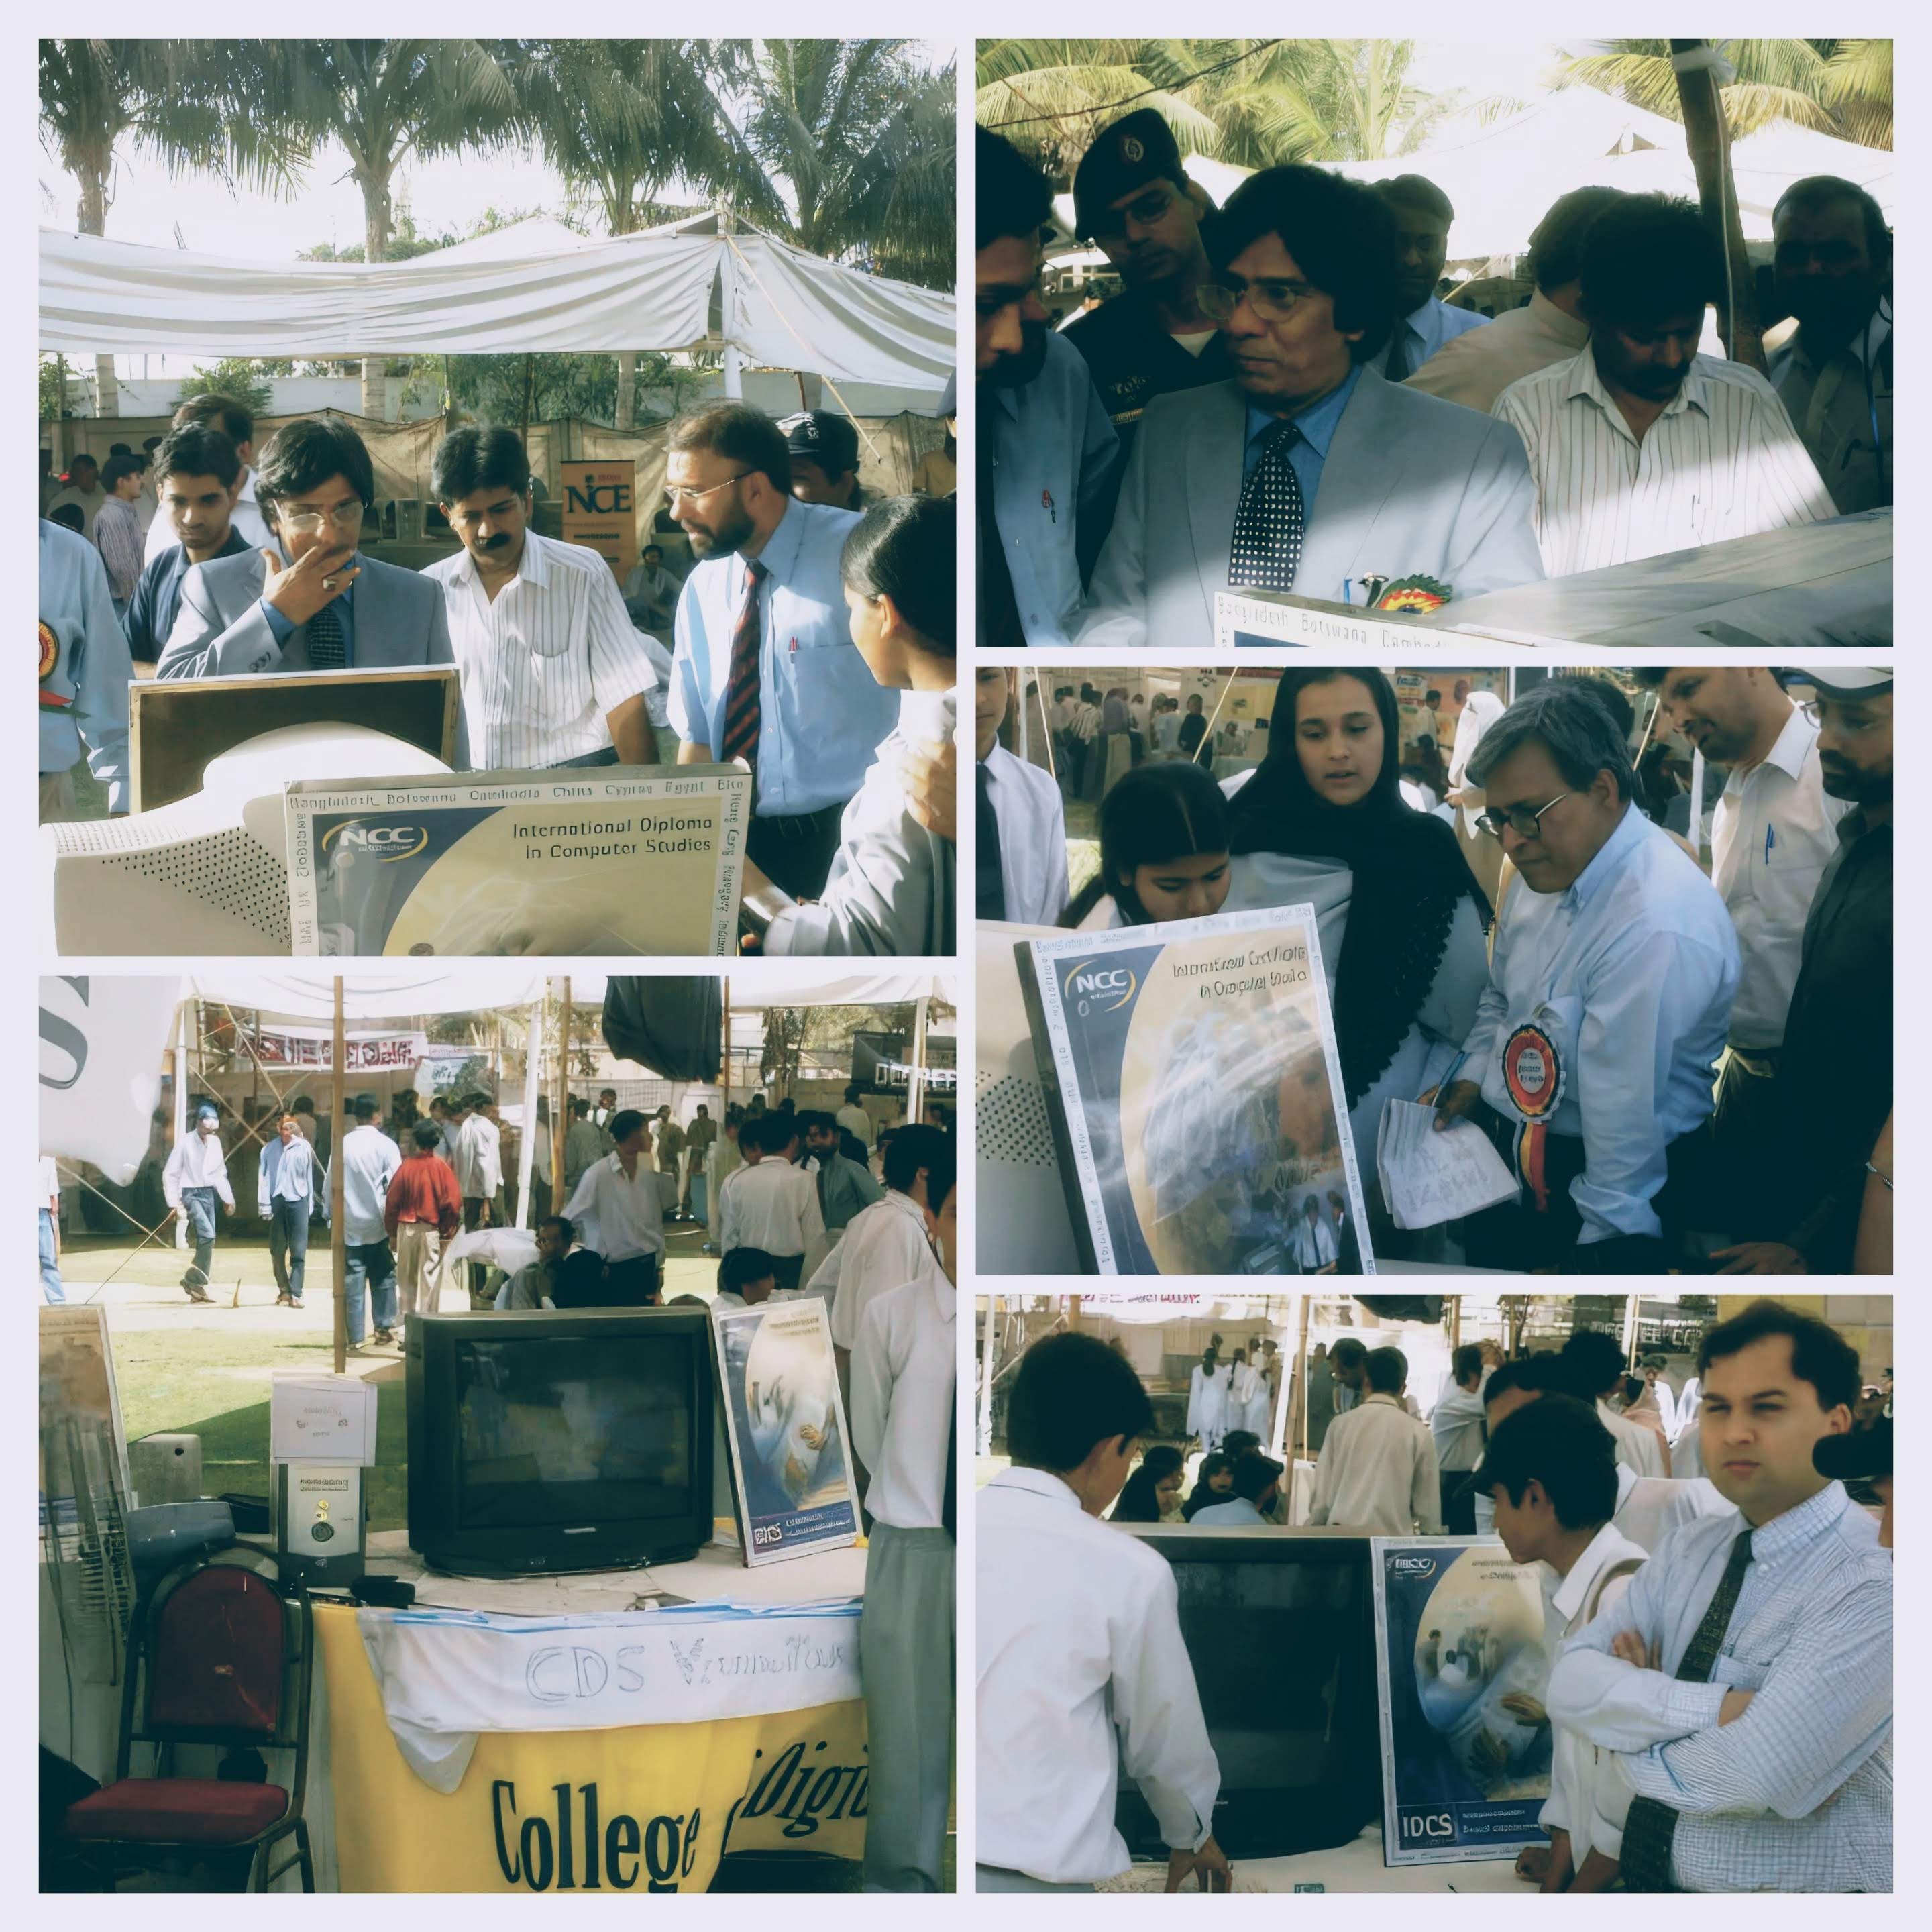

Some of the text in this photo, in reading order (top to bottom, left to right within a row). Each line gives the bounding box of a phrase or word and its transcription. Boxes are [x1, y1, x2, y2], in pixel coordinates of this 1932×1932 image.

[339, 827, 415, 847] NCC
[513, 816, 712, 839] International Diploma
[551, 844, 637, 859] Computer
[1076, 969, 1128, 994] NCC
[1403, 1813, 1453, 1837] IDCS
[492, 1780, 701, 1894] College
